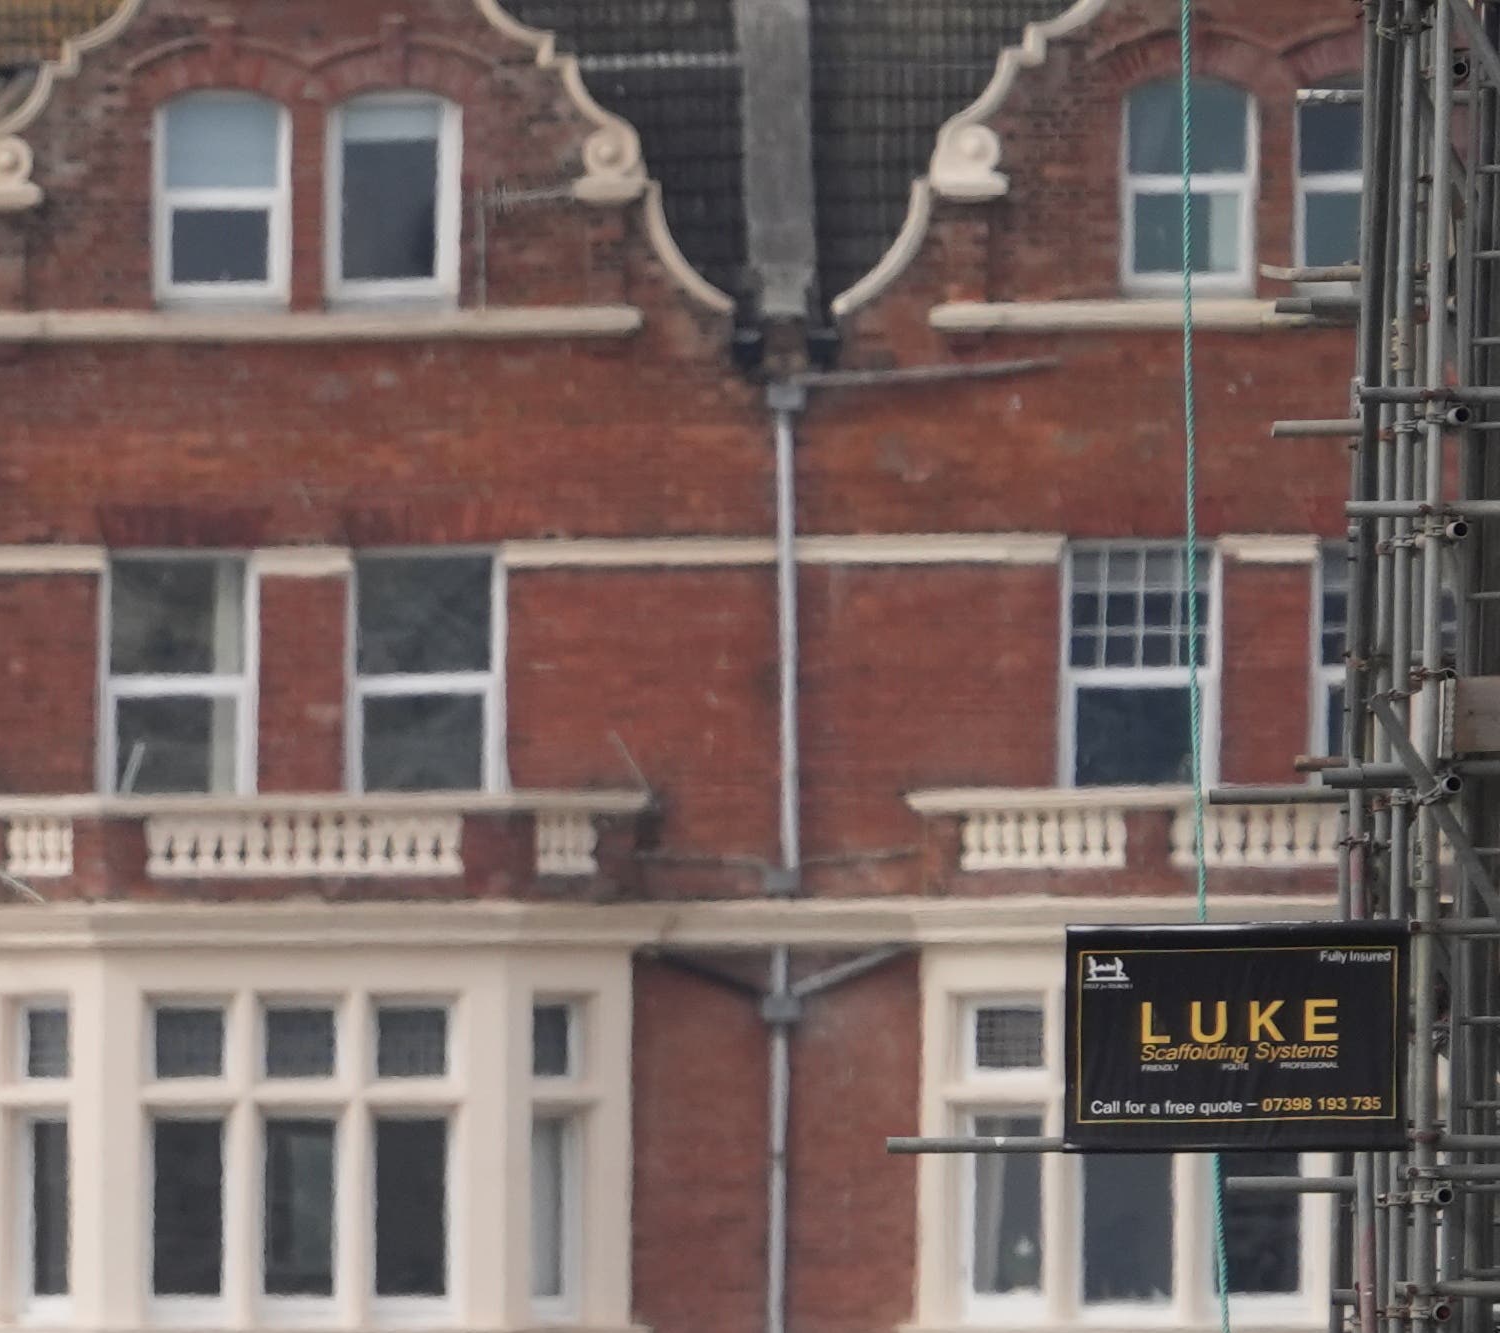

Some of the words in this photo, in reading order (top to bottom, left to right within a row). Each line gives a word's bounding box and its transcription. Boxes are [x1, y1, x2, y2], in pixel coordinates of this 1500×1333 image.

[1320, 951, 1347, 964] Fully
[1350, 951, 1391, 962] Insured
[1141, 999, 1340, 1043] LUKE
[1140, 1042, 1248, 1063] Scaffolding
[1255, 1042, 1339, 1062] Systems
[1141, 1064, 1179, 1072] FRIENDLY
[1221, 1063, 1249, 1071] POLITE
[1280, 1062, 1339, 1070] PROFESSIONAL
[1091, 1100, 1120, 1114] Call
[1125, 1100, 1146, 1114] for
[1151, 1103, 1160, 1114] a
[1165, 1100, 1195, 1114] free
[1200, 1100, 1243, 1116] quote
[1262, 1097, 1312, 1111] 07398
[1318, 1097, 1347, 1111] 193
[1352, 1096, 1381, 1111] 735
